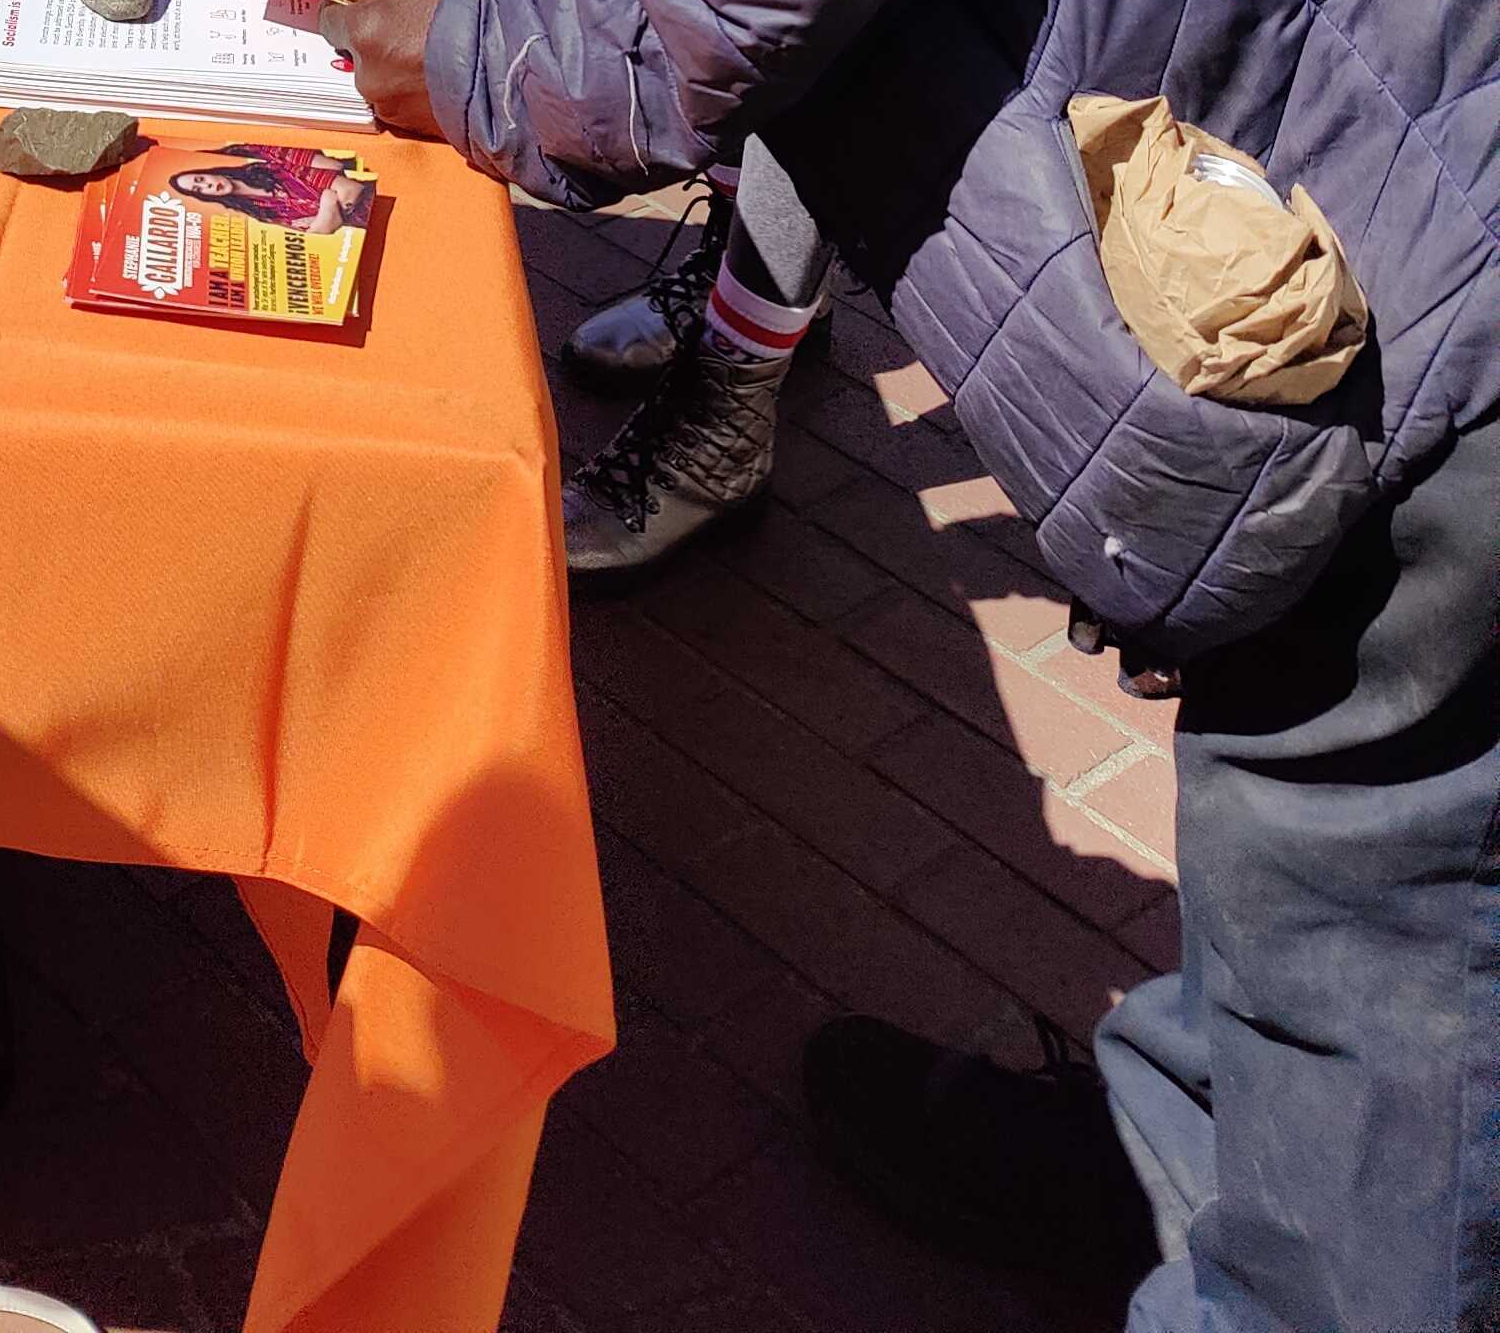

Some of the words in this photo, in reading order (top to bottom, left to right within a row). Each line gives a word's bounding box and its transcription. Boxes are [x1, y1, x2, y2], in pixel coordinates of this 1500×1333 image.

[2, 8, 18, 47] Socialism
[122, 234, 140, 279] STEPHANIE
[145, 206, 180, 283] GALLARDO
[209, 269, 229, 280] A
[230, 250, 245, 281] UNION
[285, 231, 309, 315] ¡VENCEREMOS!
[208, 280, 228, 299] AM
[230, 290, 245, 303] AM
[310, 291, 323, 304] WILL
[311, 305, 324, 315] WE
